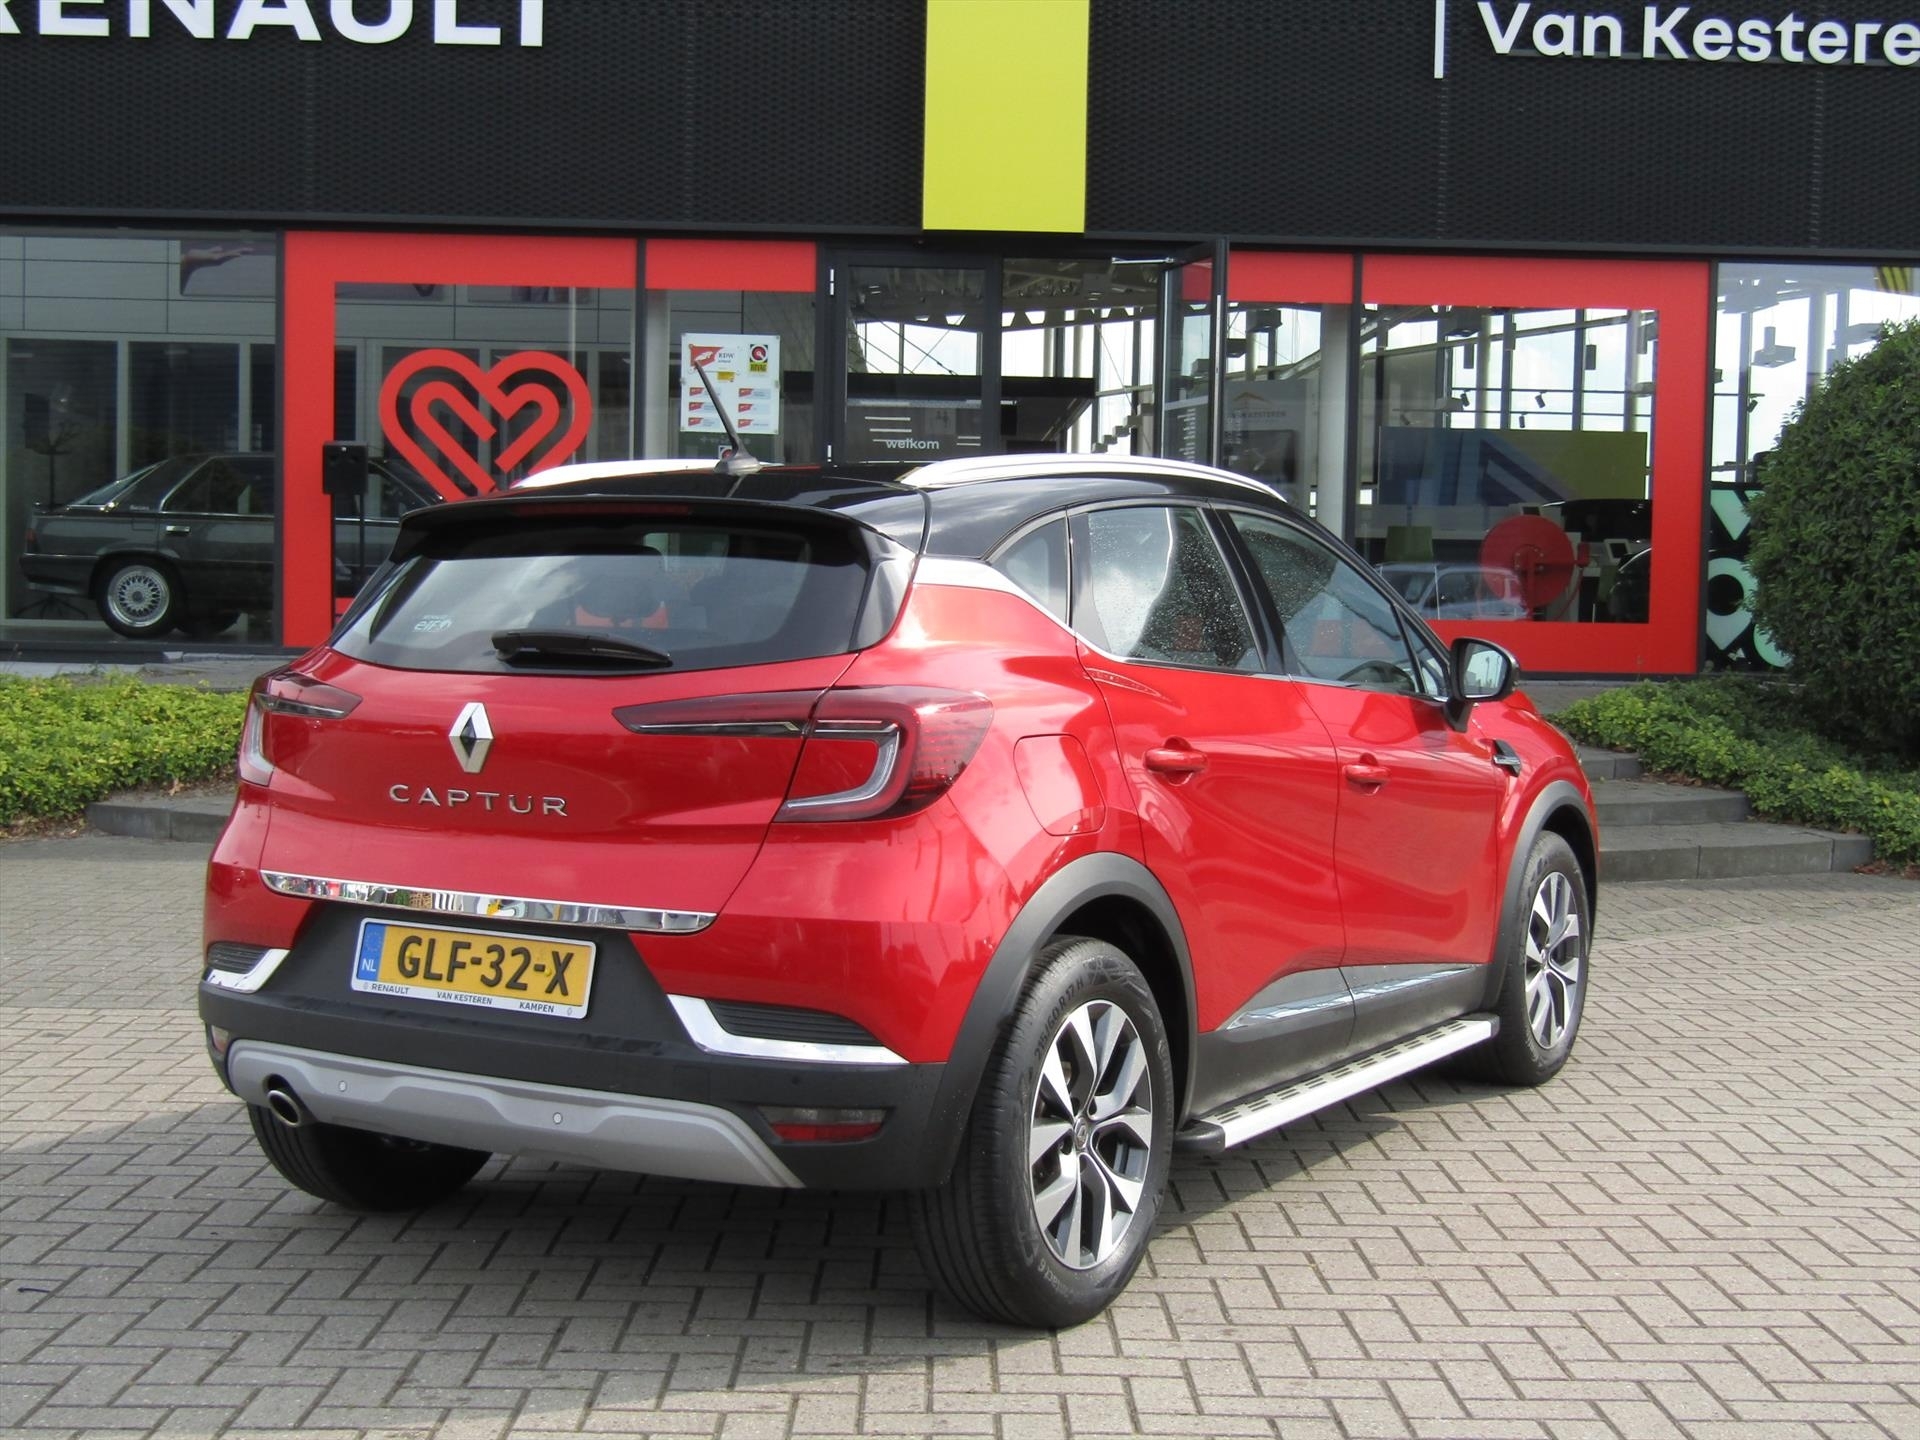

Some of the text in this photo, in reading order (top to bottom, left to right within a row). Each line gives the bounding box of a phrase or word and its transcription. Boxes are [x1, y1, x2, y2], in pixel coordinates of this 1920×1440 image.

[1477, 2, 1622, 57] Van
[886, 438, 940, 450] welkom
[389, 784, 568, 817] CAPTUR
[362, 958, 377, 972] NL
[397, 935, 575, 996] GLF-32-X
[371, 983, 555, 1013] RENAULT VAN KESTEREN KAMPEN
